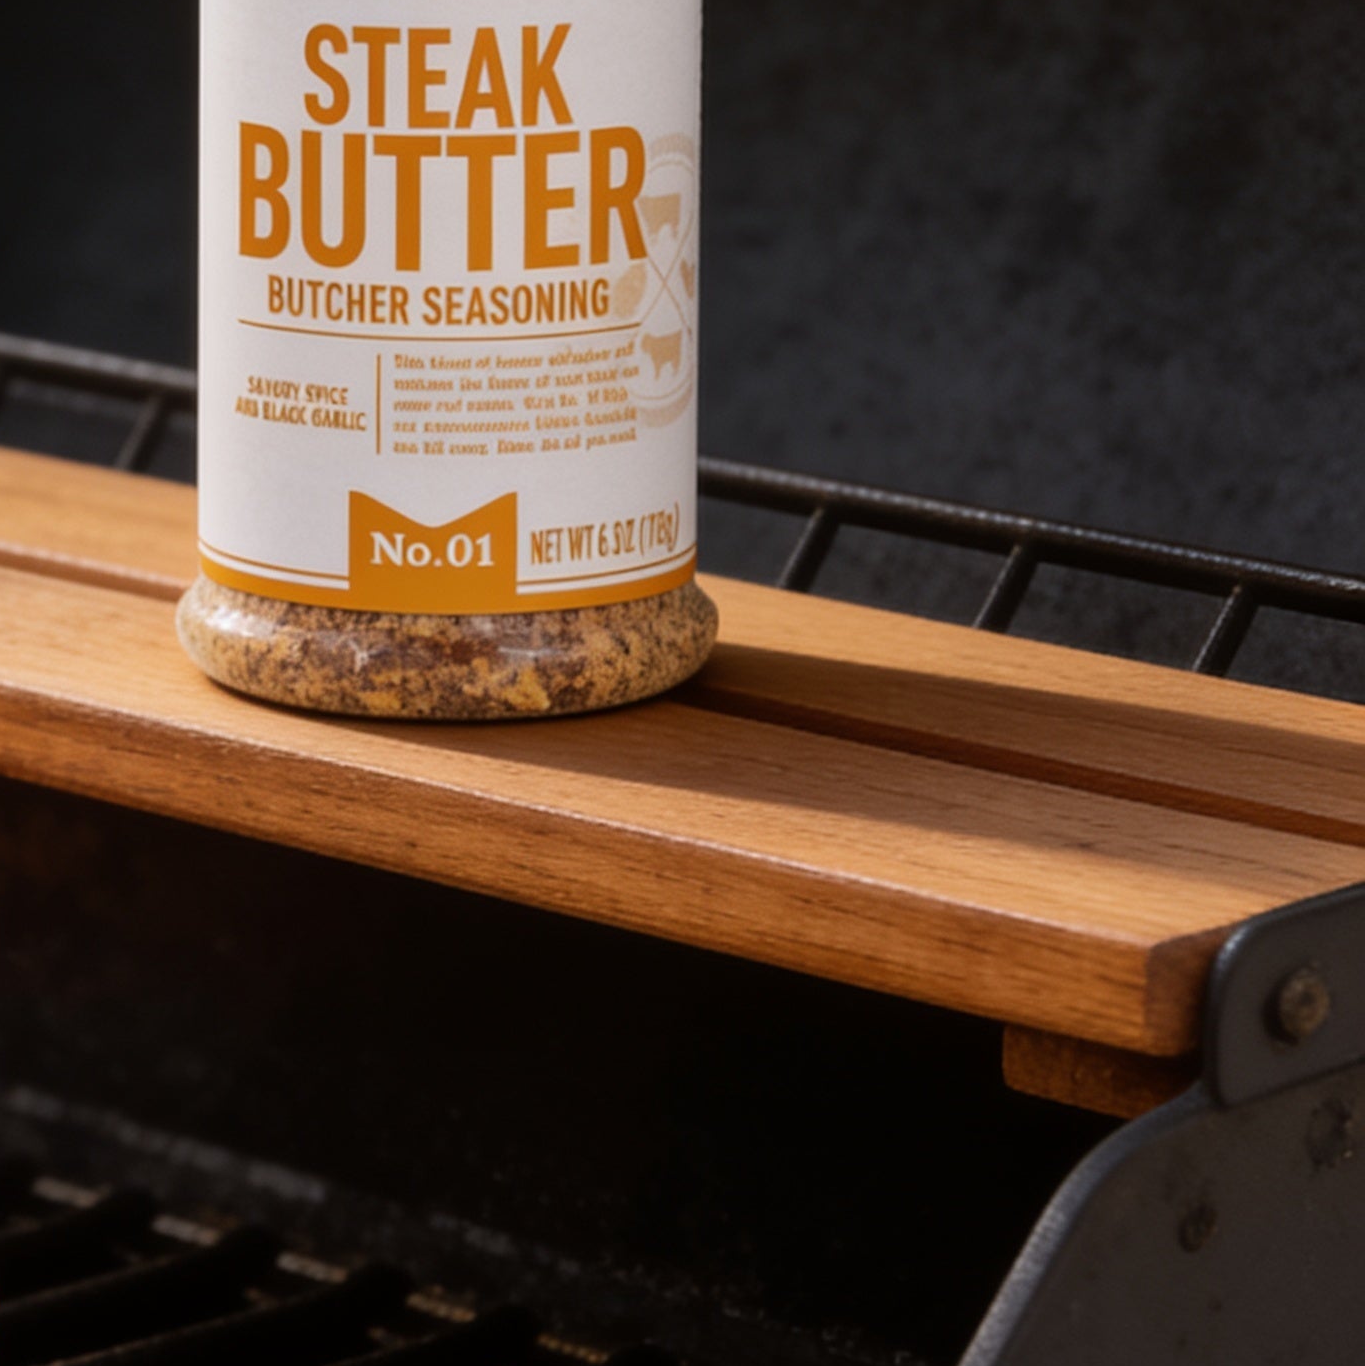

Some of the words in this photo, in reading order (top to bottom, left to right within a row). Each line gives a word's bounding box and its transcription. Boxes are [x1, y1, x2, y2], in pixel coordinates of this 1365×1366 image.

[303, 23, 574, 129] STEAK
[238, 121, 648, 273] BUTTER
[267, 274, 409, 325] BUTCHER
[422, 278, 610, 326] SEASONING
[370, 532, 495, 568] No.01
[531, 527, 564, 565] NET
[568, 524, 594, 560] WT
[598, 523, 609, 557] 6
